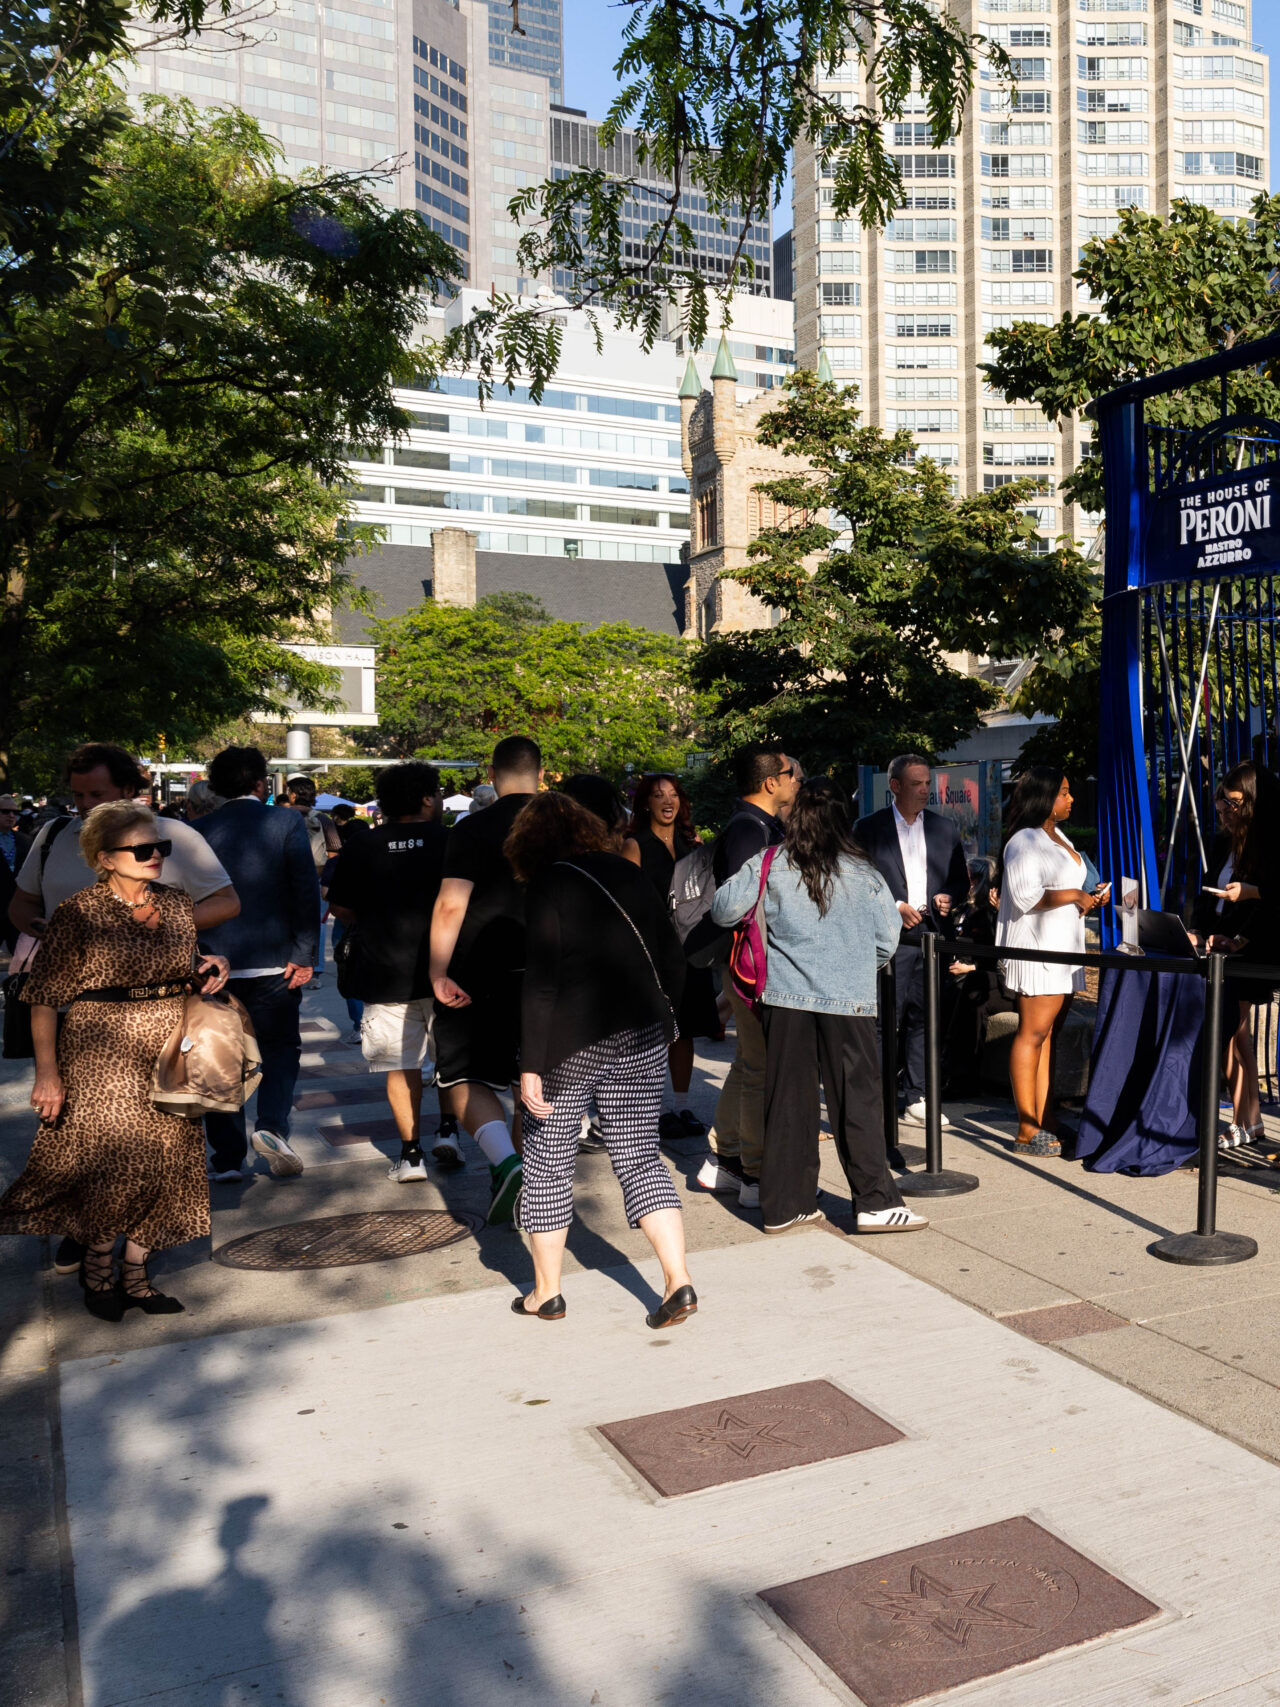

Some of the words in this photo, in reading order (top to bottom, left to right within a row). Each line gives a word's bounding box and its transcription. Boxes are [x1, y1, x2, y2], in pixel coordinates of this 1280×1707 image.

[1180, 494, 1202, 508] THE
[1207, 483, 1249, 505] HOUSE
[1255, 477, 1271, 493] OF
[1180, 494, 1271, 546] PERONI
[1196, 547, 1253, 569] AZZURRO
[1205, 538, 1244, 555] NASTRO
[945, 786, 972, 809] Square
